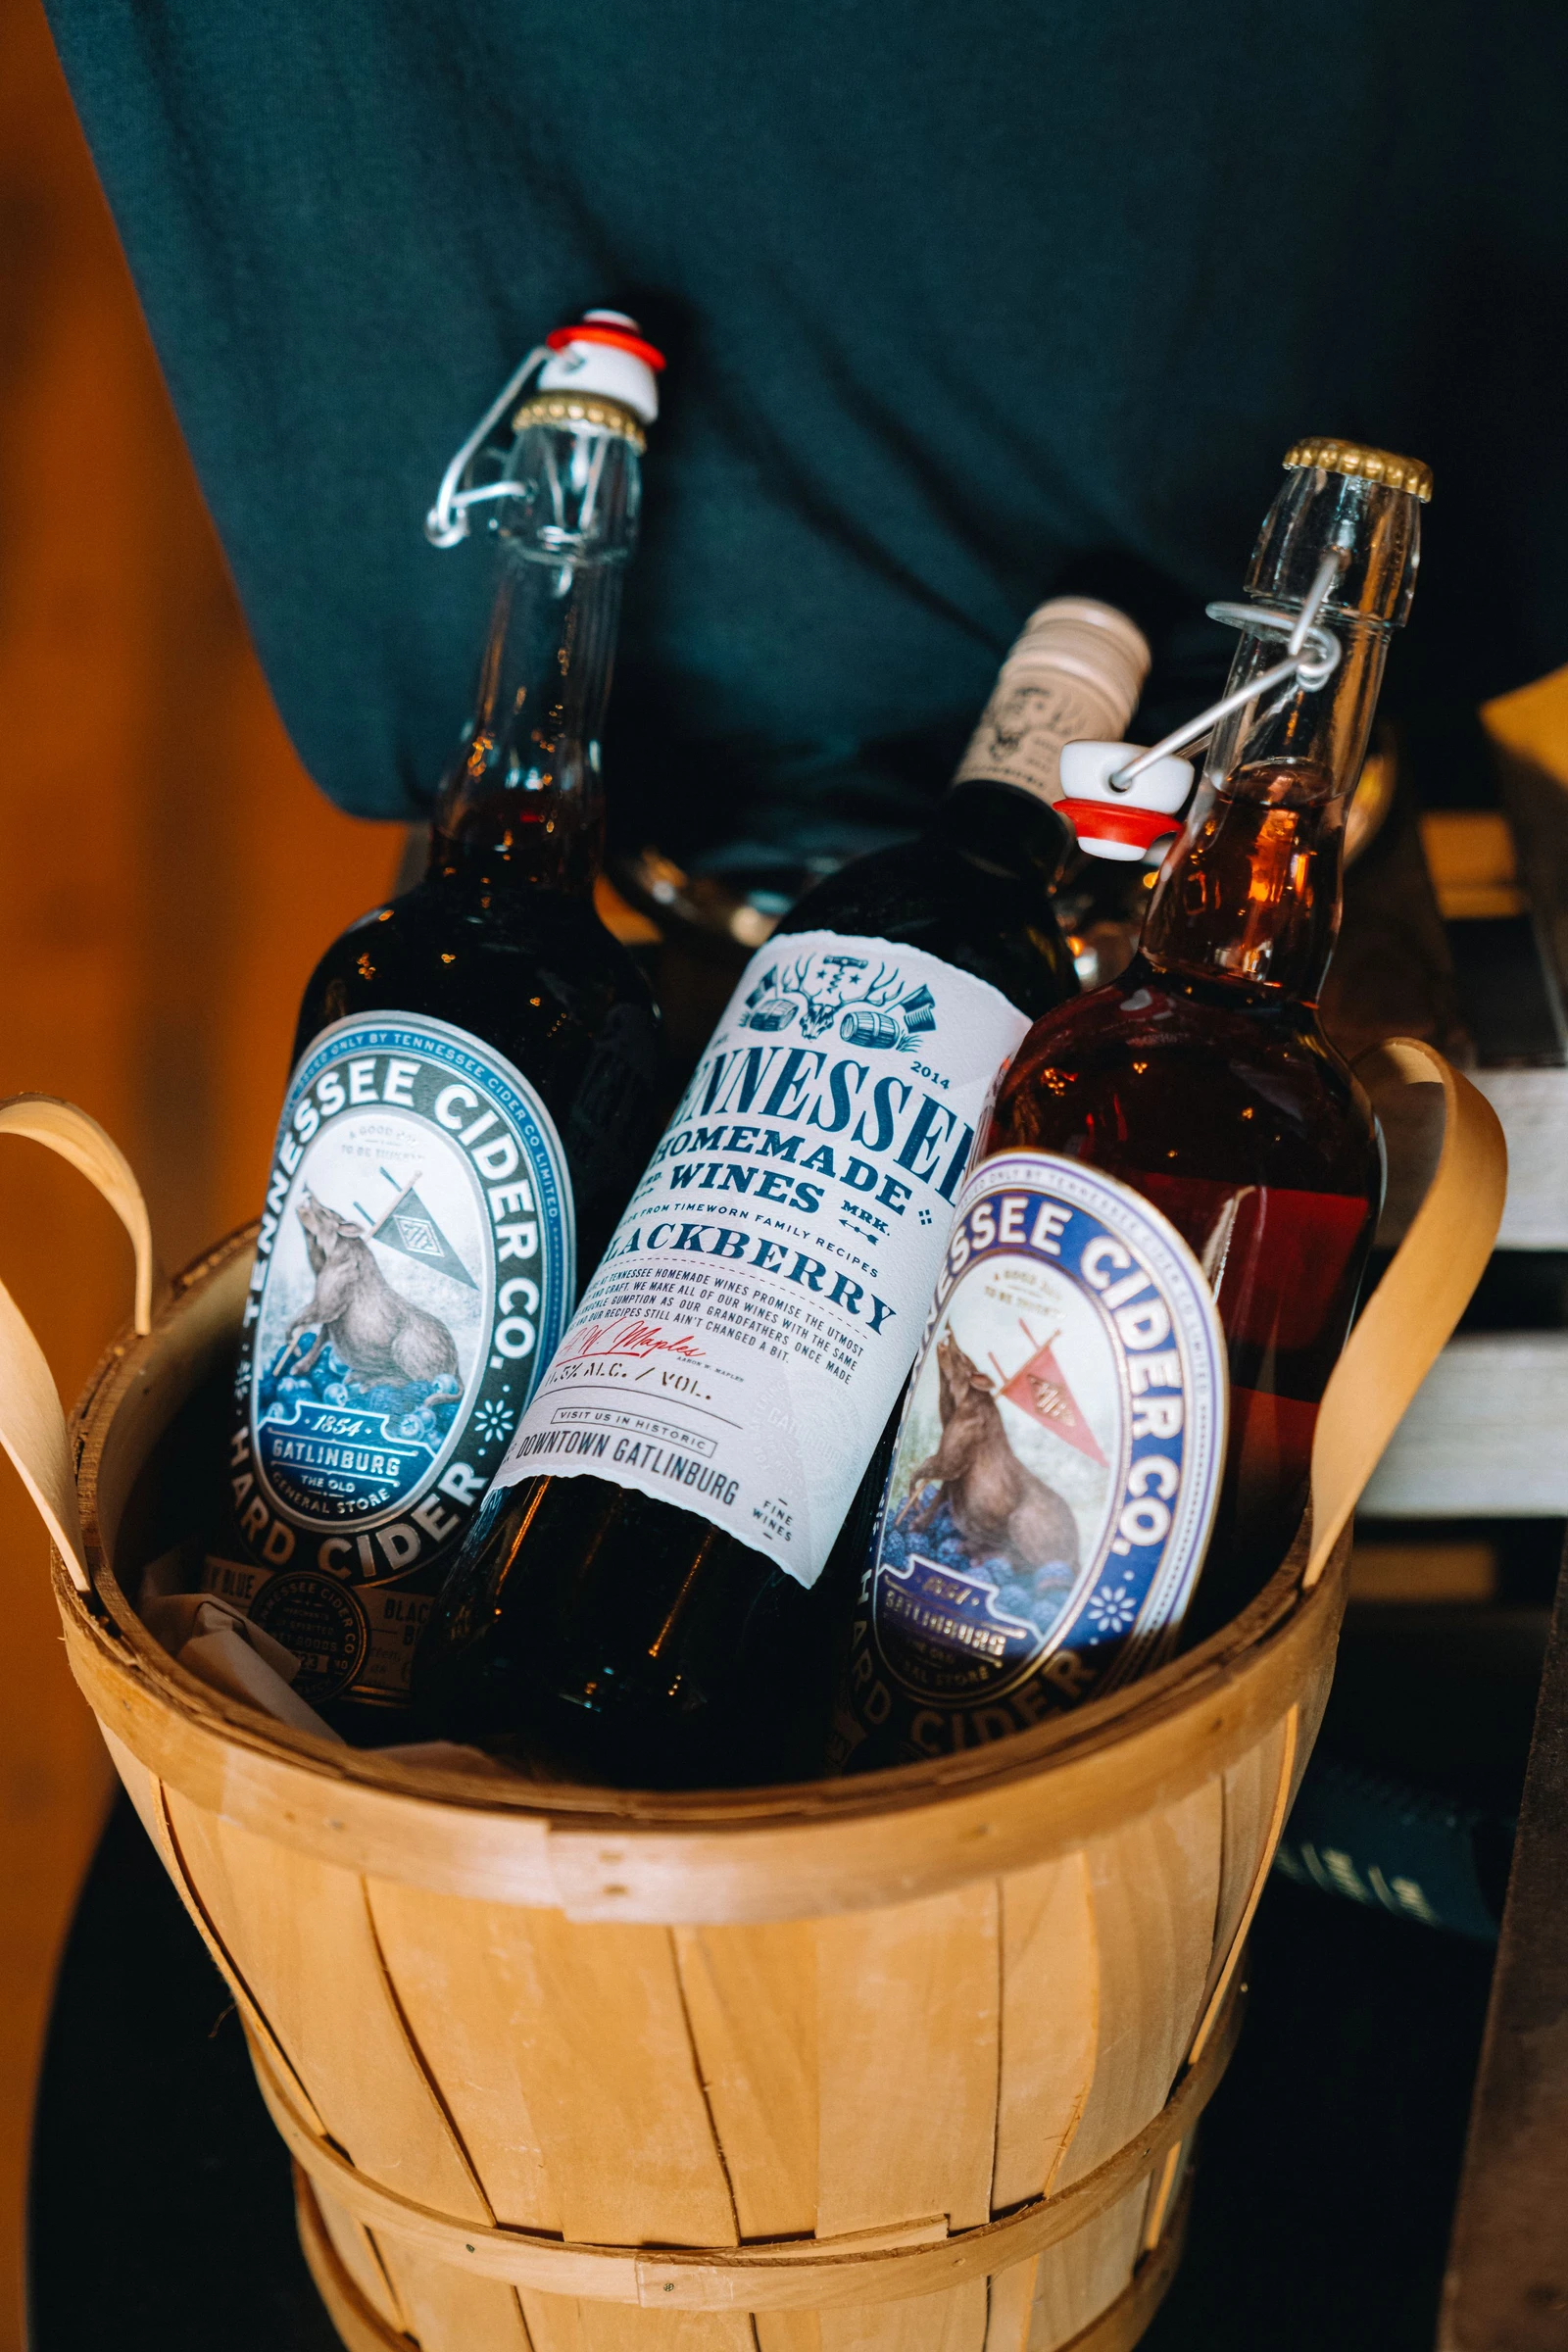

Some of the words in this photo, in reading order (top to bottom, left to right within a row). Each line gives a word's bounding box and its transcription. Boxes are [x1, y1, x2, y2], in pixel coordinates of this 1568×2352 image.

[369, 1034, 387, 1044] BY
[394, 1033, 485, 1078] TENNESSEE
[488, 1079, 526, 1121] CIDER
[524, 1125, 540, 1148] CO
[909, 1060, 951, 1091] 2014
[650, 1125, 912, 1216] HOMEMADE
[669, 1162, 824, 1214] WINES
[243, 1057, 421, 1328] TENNESSEE
[434, 1084, 539, 1262] CIDER
[489, 1277, 538, 1369] CO.
[841, 1199, 892, 1237] MRK.
[640, 1203, 670, 1217] FROM
[674, 1203, 750, 1219] TIMEWORN
[755, 1214, 811, 1240] FAMILY
[815, 1237, 879, 1278] RECIPES
[602, 1222, 897, 1336] LACKBERRY
[588, 1310, 604, 1322] OUR
[605, 1307, 643, 1319] RECIPES
[643, 1308, 669, 1321] STILL
[673, 1313, 704, 1328] AIN'T
[706, 1321, 757, 1347] CHANGED
[759, 1341, 766, 1351] A
[769, 1346, 790, 1363] BIT.
[610, 1267, 654, 1283] TENNESSEE
[655, 1267, 710, 1286] HOMEMADE
[713, 1277, 750, 1296] WINES
[752, 1290, 803, 1319] PROMISE
[804, 1313, 825, 1332] THE
[826, 1326, 864, 1357] UTMOST
[633, 1281, 647, 1292] WE
[649, 1281, 675, 1294] MAKE
[677, 1285, 696, 1298] ALL
[699, 1289, 715, 1300] OF
[716, 1294, 741, 1309] OUR
[743, 1300, 779, 1325] WINES
[782, 1318, 809, 1340] WITH
[811, 1334, 832, 1352] THE
[832, 1348, 858, 1372] SAME
[1080, 1235, 1184, 1441] CIDER
[611, 1294, 657, 1305] GUMPTION
[660, 1296, 675, 1307] AS
[678, 1298, 702, 1312] OUR
[707, 1305, 790, 1346] GRANDFATHERS
[794, 1342, 823, 1364] ONCE
[825, 1360, 853, 1386] MADE
[584, 1361, 627, 1378] ALC.
[635, 1366, 656, 1381] /
[662, 1371, 711, 1400] VOL.
[311, 1414, 364, 1438] 1854
[594, 1412, 612, 1421] US
[616, 1415, 630, 1425] IN
[636, 1420, 707, 1450] HISTORIC
[271, 1439, 401, 1476] GATLINBURG
[302, 1474, 324, 1488] THE
[327, 1479, 356, 1494] OLD
[515, 1430, 612, 1459] DOWNTOWN
[612, 1438, 740, 1507] GATLINBURG
[230, 1426, 296, 1566] HARD
[317, 1461, 489, 1580] CIDER
[272, 1471, 331, 1514] GENERAL
[336, 1487, 390, 1514] STORE
[762, 1499, 794, 1527] FINE
[1111, 1454, 1181, 1557] CO.
[753, 1507, 793, 1543] WINES
[320, 1587, 354, 1628] CIDER
[384, 1598, 429, 1624] BLAC
